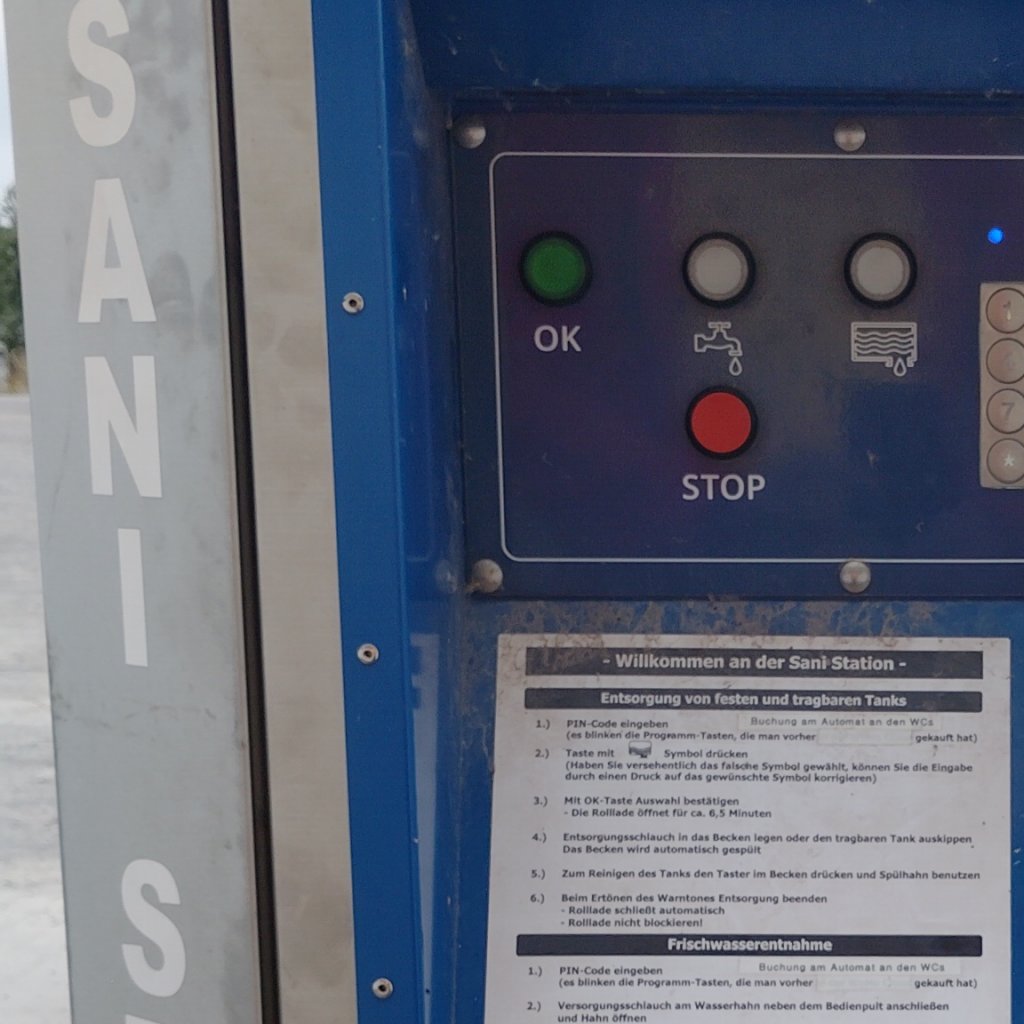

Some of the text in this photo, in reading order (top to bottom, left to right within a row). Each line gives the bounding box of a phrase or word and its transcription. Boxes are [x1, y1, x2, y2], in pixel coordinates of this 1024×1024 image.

[67, 0, 163, 667] SANI
[533, 325, 582, 353] OK
[1001, 402, 1015, 421] 7
[682, 473, 766, 502] STOP
[615, 654, 894, 671] Willkommen an der Sani Station
[601, 692, 907, 708] Entsorgung von festen und tragbaren Tanks
[751, 716, 934, 728] Buchung am Automat an den WCs
[534, 795, 739, 808] 3.) Mit OK-Taste Auswahl bestätigen
[530, 892, 827, 906] 6.) Beim Ertönen des Warntones Entsorgung beenden
[668, 937, 833, 951] Frischwasserentnahme
